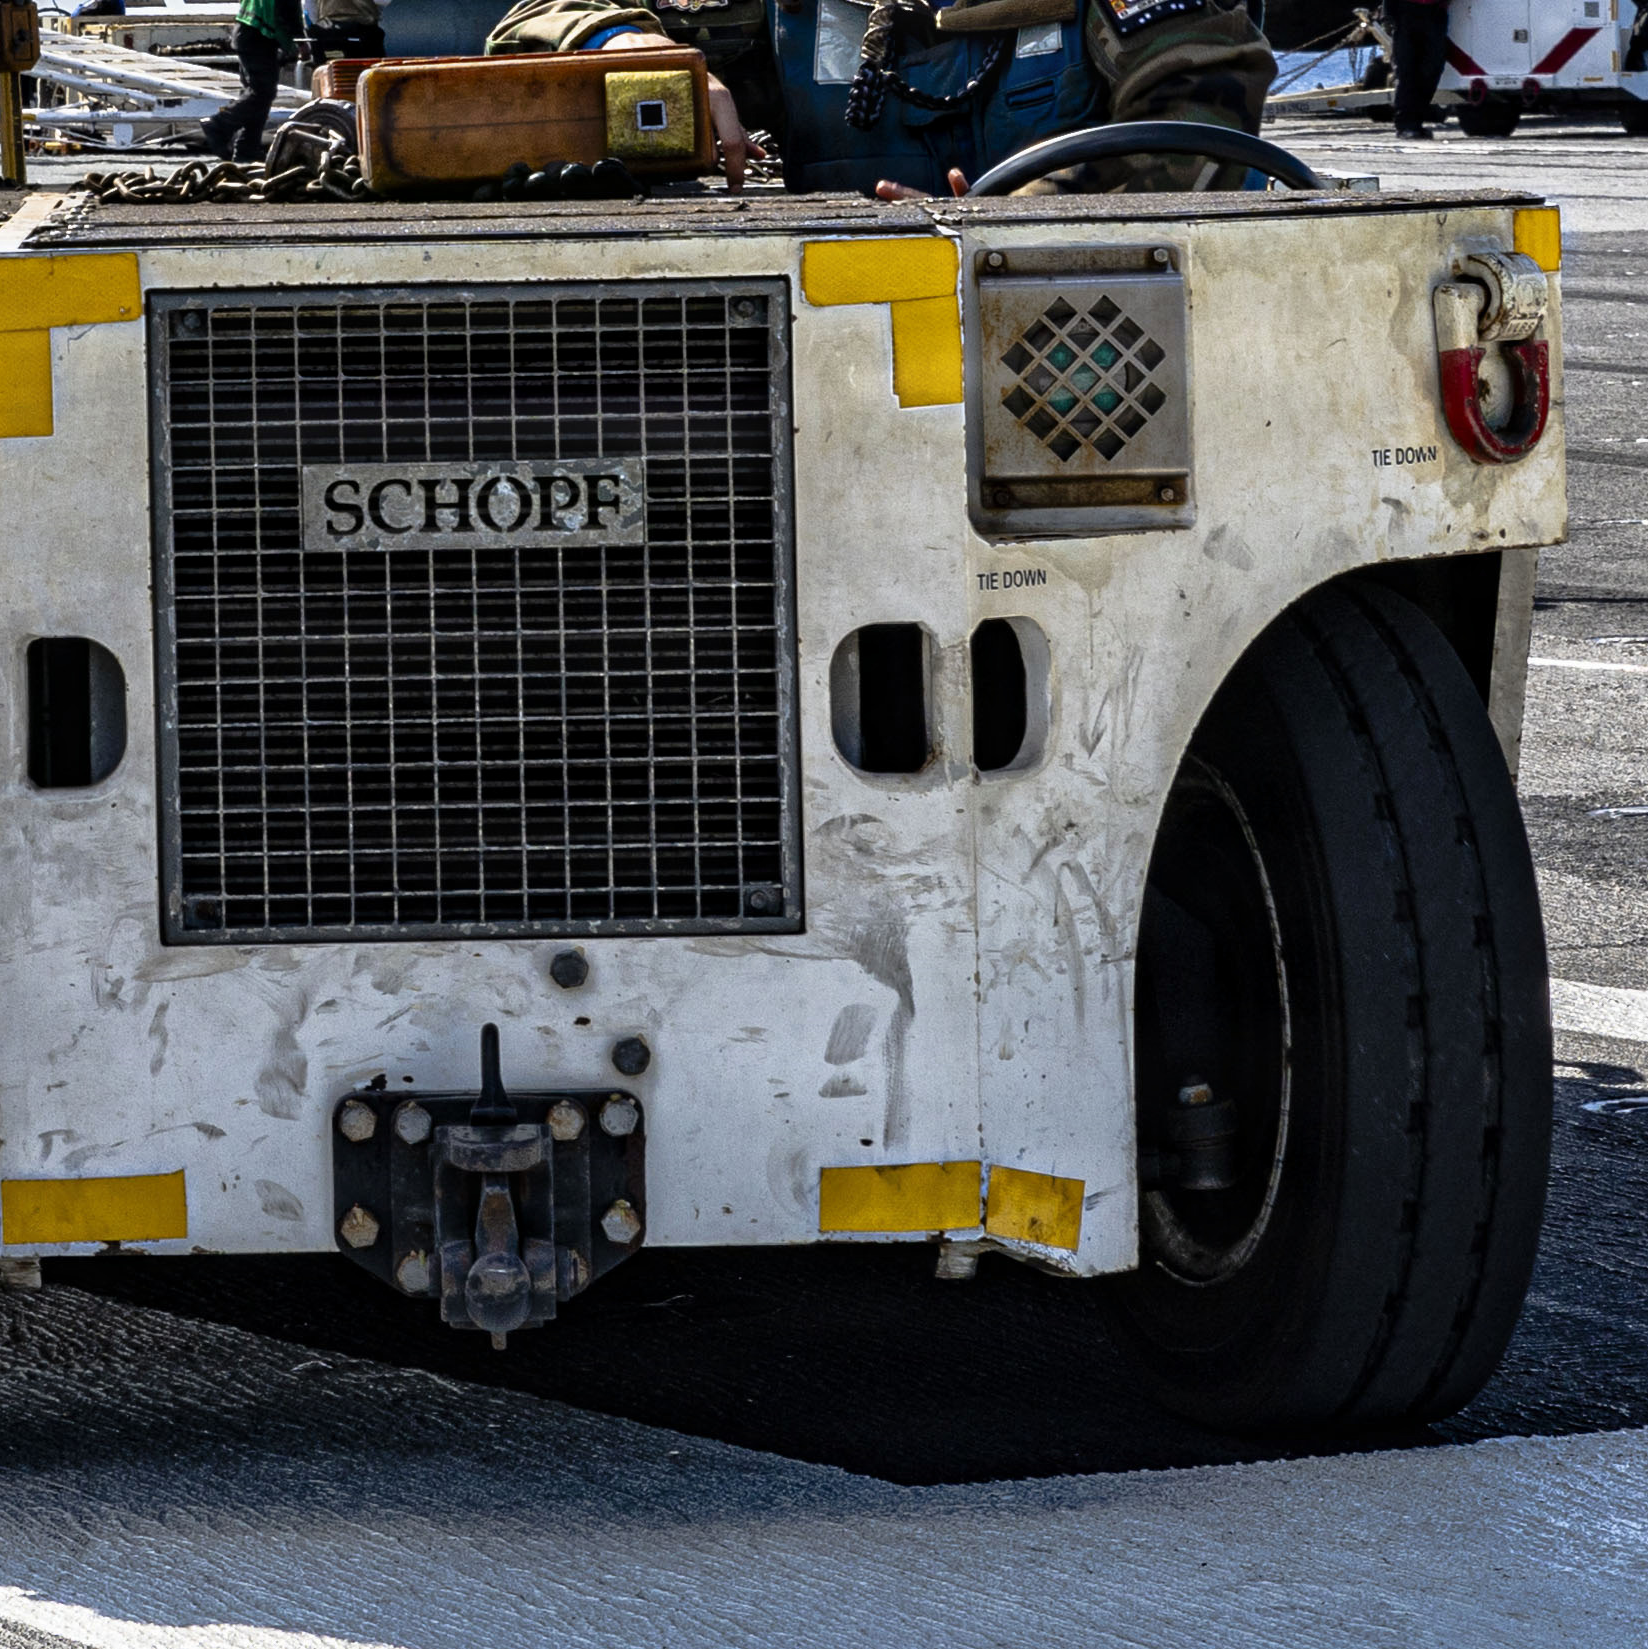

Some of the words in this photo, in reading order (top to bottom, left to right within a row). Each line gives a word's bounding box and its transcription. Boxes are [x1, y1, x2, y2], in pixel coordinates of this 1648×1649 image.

[1372, 449, 1391, 467] TIE
[1395, 446, 1437, 465] DOWN
[324, 474, 620, 536] SCHOPF
[976, 572, 999, 590] TIE
[1003, 568, 1046, 589] DOWN
